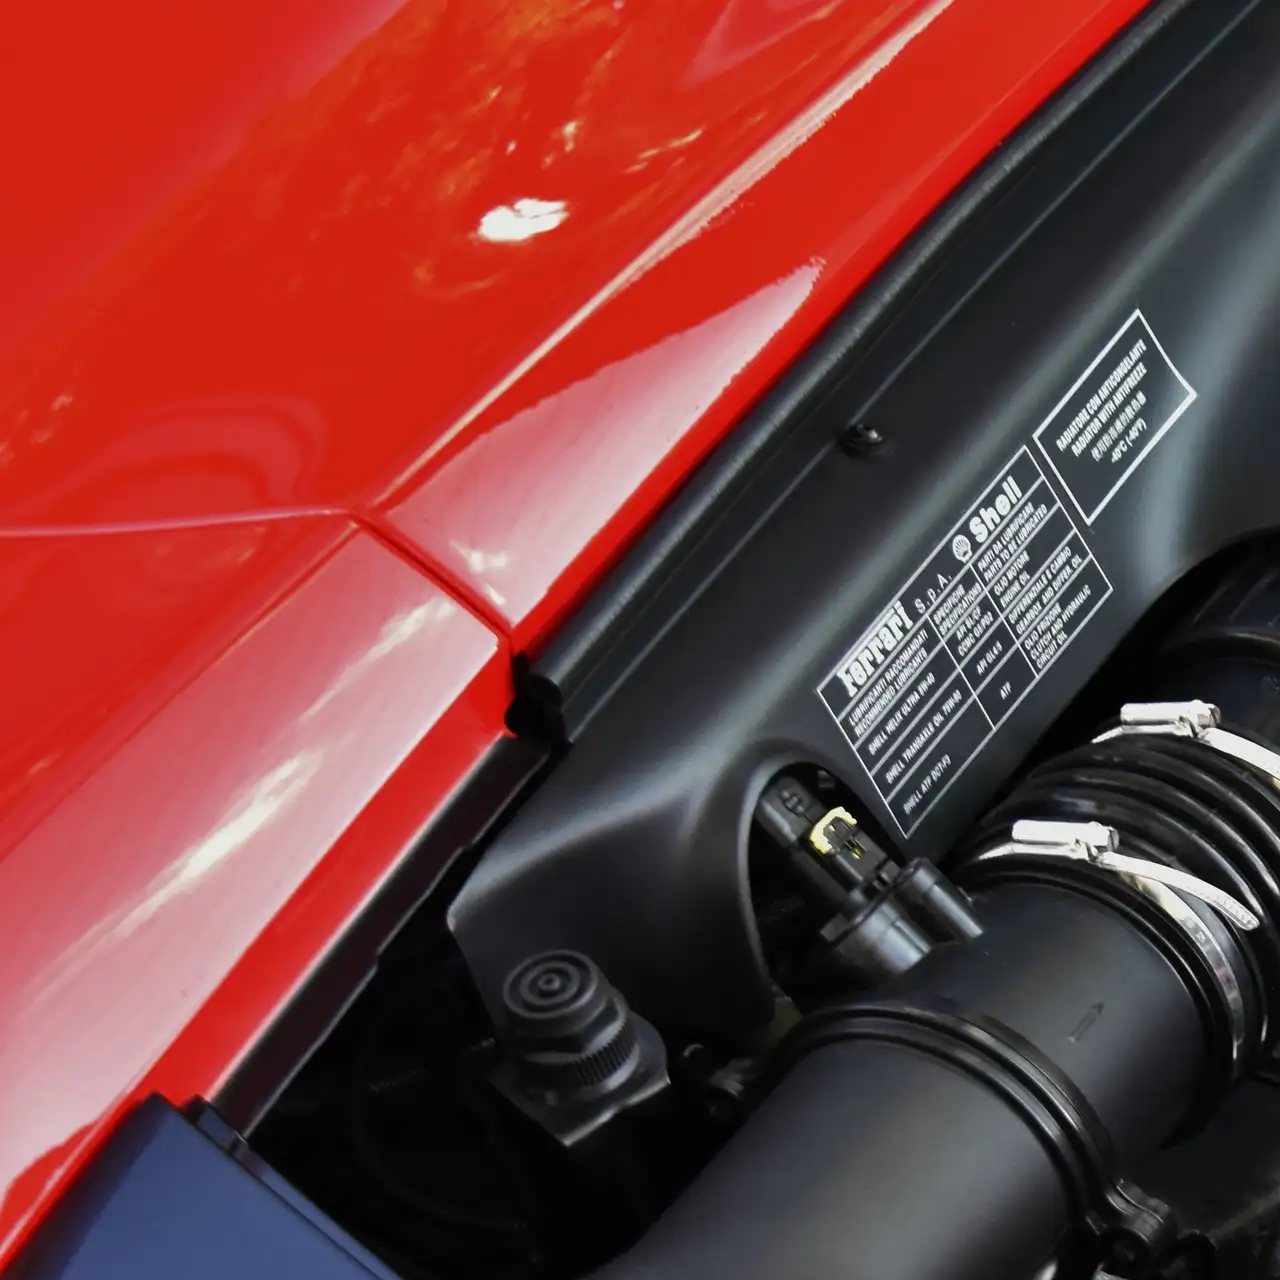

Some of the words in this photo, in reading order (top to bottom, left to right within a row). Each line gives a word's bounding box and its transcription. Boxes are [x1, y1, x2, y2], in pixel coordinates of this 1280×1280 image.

[1056, 408, 1090, 451] RADIATORE
[1086, 393, 1102, 415] CON
[1071, 417, 1103, 457] RADIATOR
[1097, 399, 1116, 424] WITH
[1112, 362, 1147, 407] ANTIFREEZE
[968, 475, 1022, 543] Shell
[977, 549, 996, 573] PARTI
[992, 540, 1003, 555] DA
[1000, 502, 1035, 546] LUBRIFICARE
[983, 557, 1003, 583] PARTS
[998, 549, 1012, 564] TO
[1008, 538, 1020, 556] BE
[1015, 504, 1048, 545] LUBRICATED
[994, 576, 1008, 596] OLIO
[1006, 550, 1030, 581] MOTORE
[939, 582, 982, 638] SPECIFICATIONS
[1000, 580, 1022, 609] ENGINE
[1019, 571, 1031, 586] OIL
[1008, 574, 1048, 624] DIFFERENZIALE
[1045, 569, 1052, 580] E
[1050, 546, 1071, 574] CAMBIO
[1016, 600, 1042, 637] GEARBOX
[1042, 586, 1054, 606] AND
[1071, 554, 1084, 570] OIL
[836, 600, 914, 698] Ferrari
[956, 623, 967, 641] API
[1024, 630, 1039, 650] OLIO
[1037, 602, 1062, 635] FRIZIONE
[1030, 631, 1054, 661] CLUTCH
[1051, 618, 1063, 636] AND
[1061, 585, 1091, 623] HYDRAULIC
[1036, 639, 1058, 672] CIRCUIT
[1056, 630, 1068, 645] OIL
[848, 677, 887, 727] LUBRIFICANTI
[884, 629, 928, 683] RACCOMANDATI
[854, 685, 896, 738] RECOMMENDED
[894, 647, 929, 692] LUBRICANTS
[977, 658, 988, 675] API
[868, 731, 888, 755] SHELL
[885, 710, 903, 735] HELIX
[901, 691, 920, 716] ULTRA
[886, 760, 905, 784] SHELL
[902, 722, 935, 763] TRANSAXLE
[933, 712, 944, 727] OIL
[904, 790, 922, 814] SHELL
